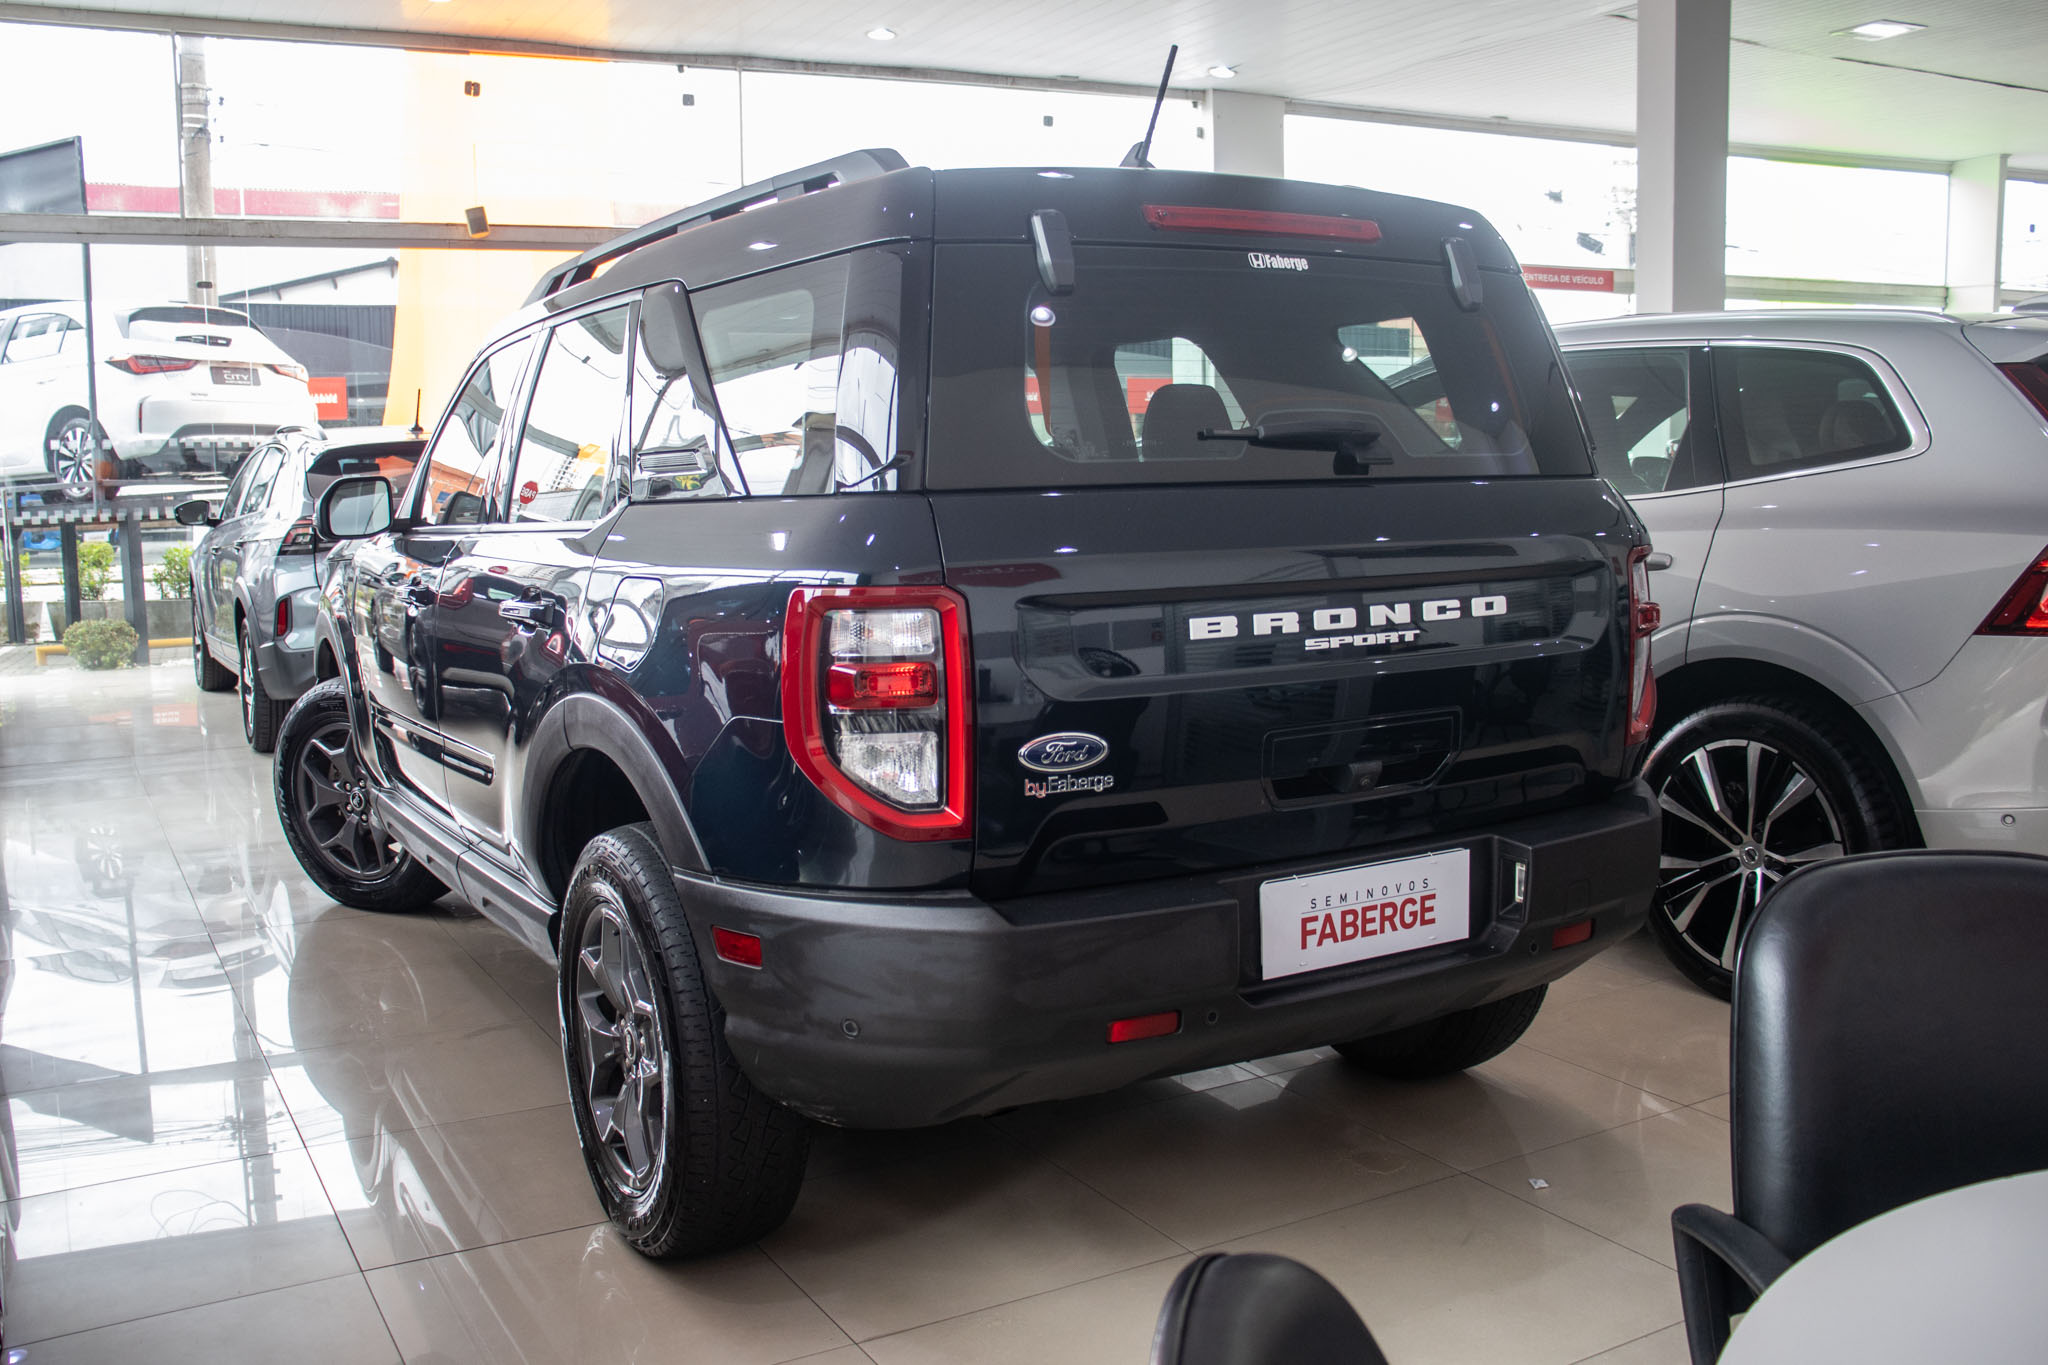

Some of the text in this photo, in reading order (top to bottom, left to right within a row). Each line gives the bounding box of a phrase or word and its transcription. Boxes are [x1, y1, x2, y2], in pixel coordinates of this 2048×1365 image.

[1264, 254, 1309, 271] Faberge
[1524, 272, 1604, 285] ENTREGA DE VEÍCULO
[223, 373, 249, 381] CITY
[1188, 595, 1508, 641] BRONCO
[1304, 629, 1421, 651] SPORT
[1040, 740, 1089, 765] Ford
[1310, 878, 1430, 909] SEMINOVOS
[1300, 893, 1437, 950] FABERGE
